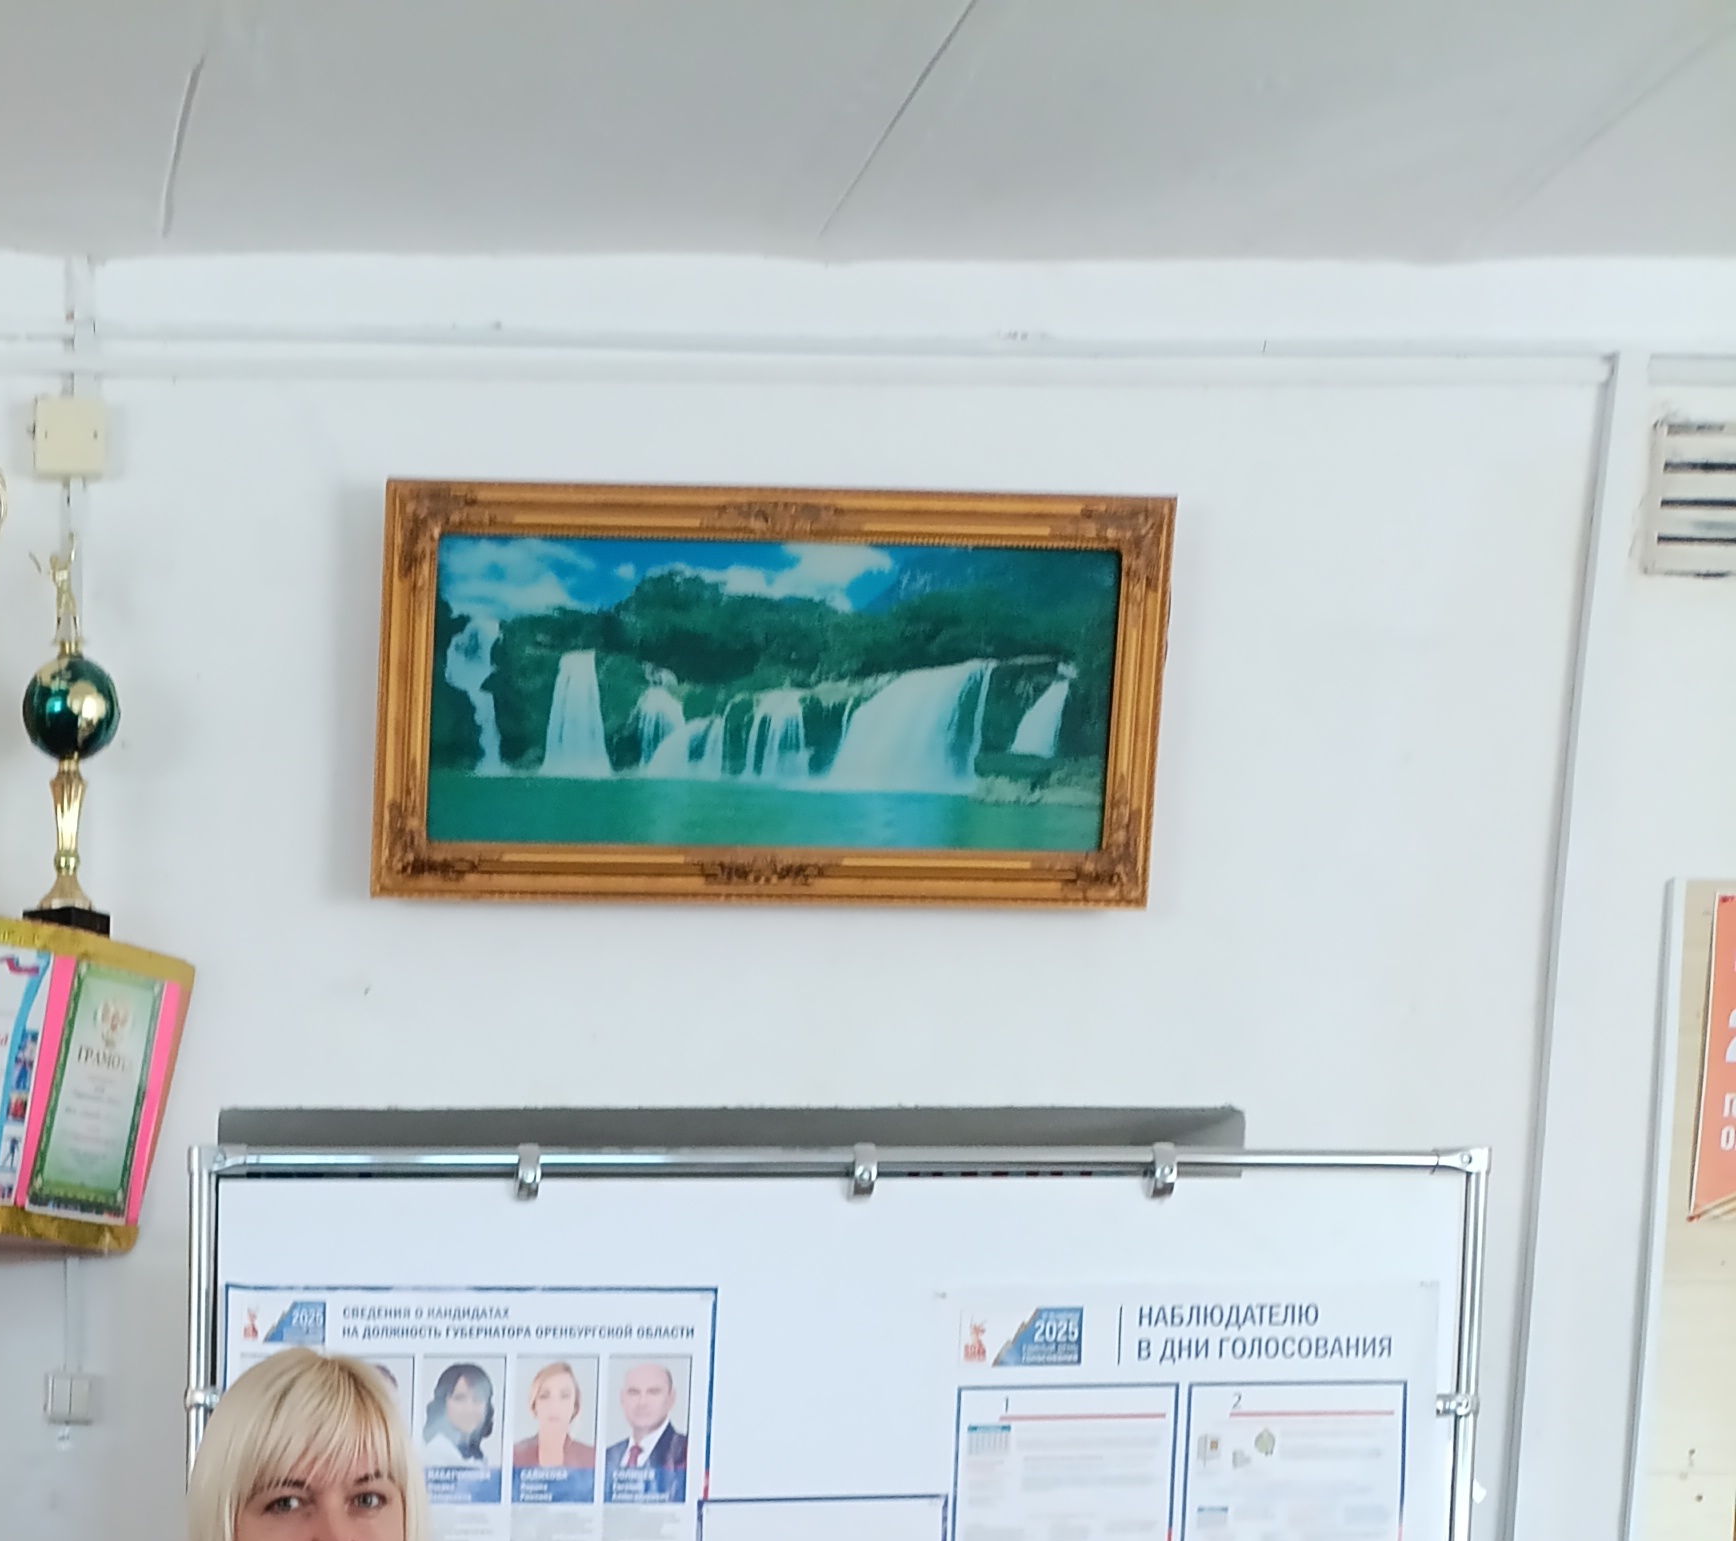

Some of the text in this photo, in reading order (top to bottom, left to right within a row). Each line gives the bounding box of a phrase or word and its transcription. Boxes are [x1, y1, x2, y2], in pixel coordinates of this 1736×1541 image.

[342, 1306, 510, 1322] СВЕДЕНИЯ О КАНДИДАТАХ
[1138, 1303, 1319, 1331] НАБЛЮДАТЕЛЮ
[342, 1323, 695, 1341] НА ДОЛЖНОСТЬ ГУБЕРНАТОРА ОРЕНБУРГСКОЙ ОБЛАСТИ
[1137, 1335, 1393, 1364] В ДНИ ГОЛОСОВАНИЯ
[1232, 1393, 1243, 1410] 2
